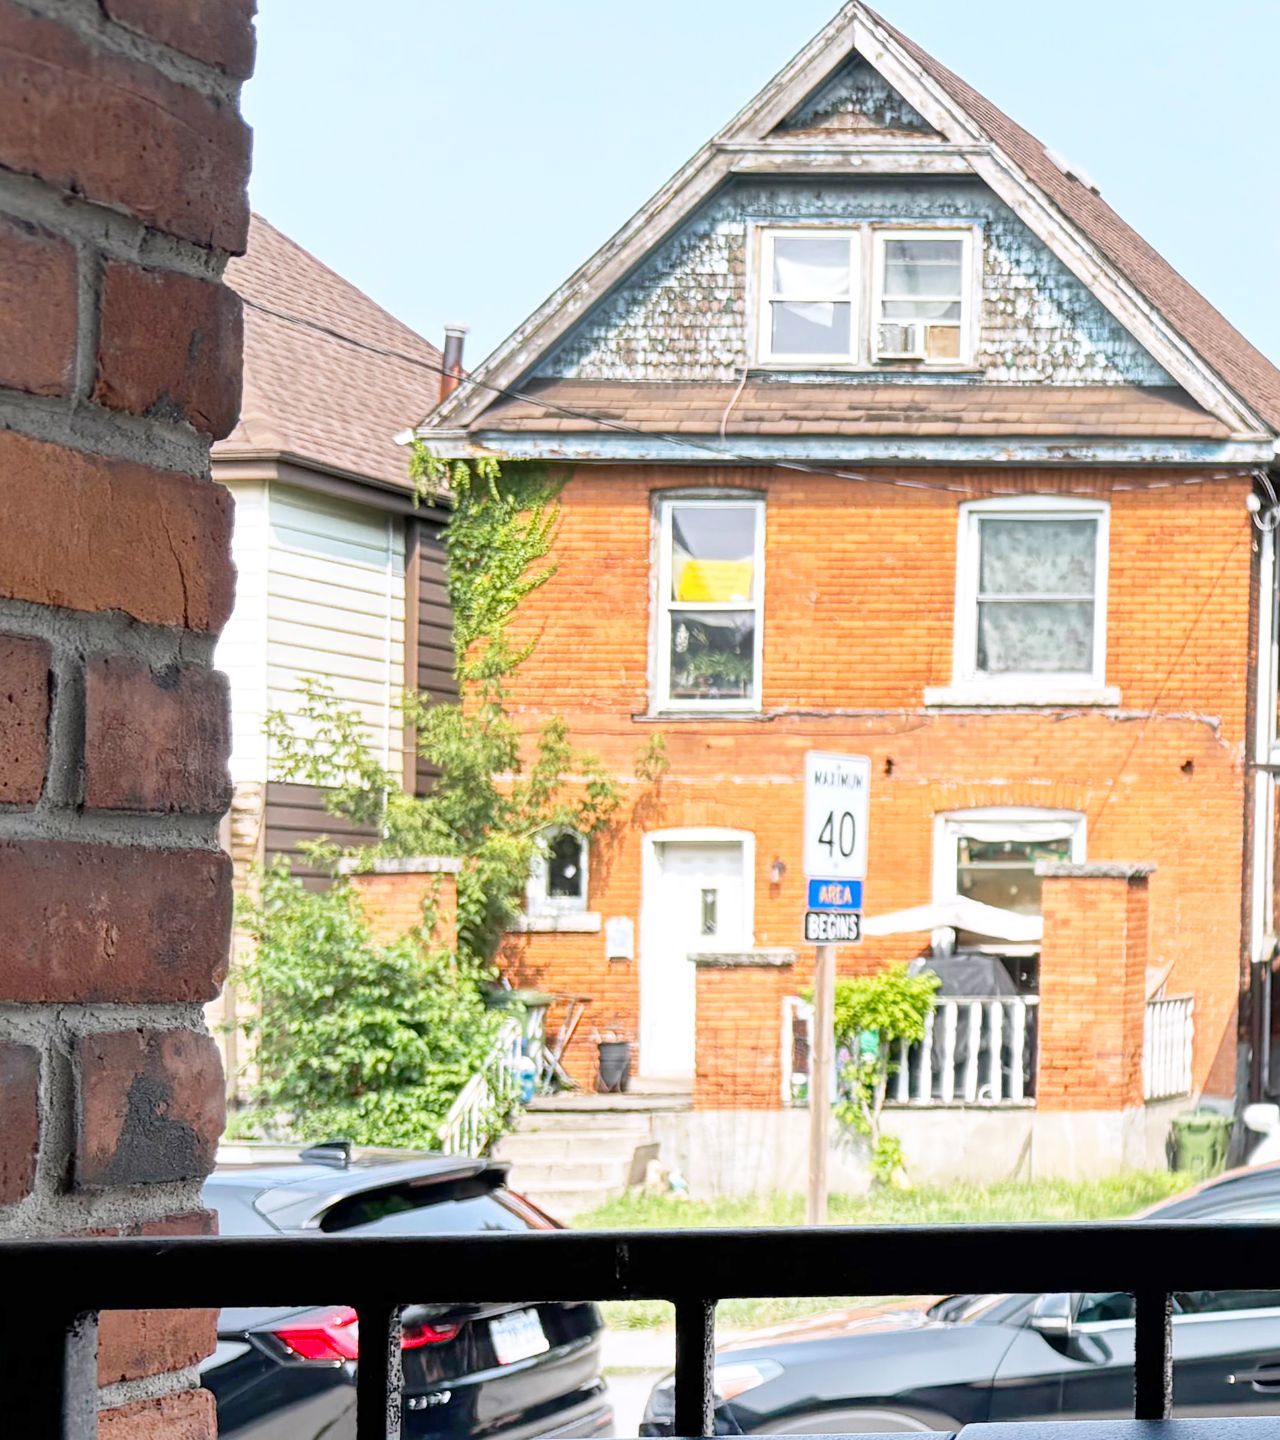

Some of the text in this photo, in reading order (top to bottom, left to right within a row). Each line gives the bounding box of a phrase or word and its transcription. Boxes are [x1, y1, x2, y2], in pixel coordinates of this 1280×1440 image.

[818, 811, 856, 857] 40
[819, 885, 853, 905] AREA
[807, 913, 858, 940] BEGINS
